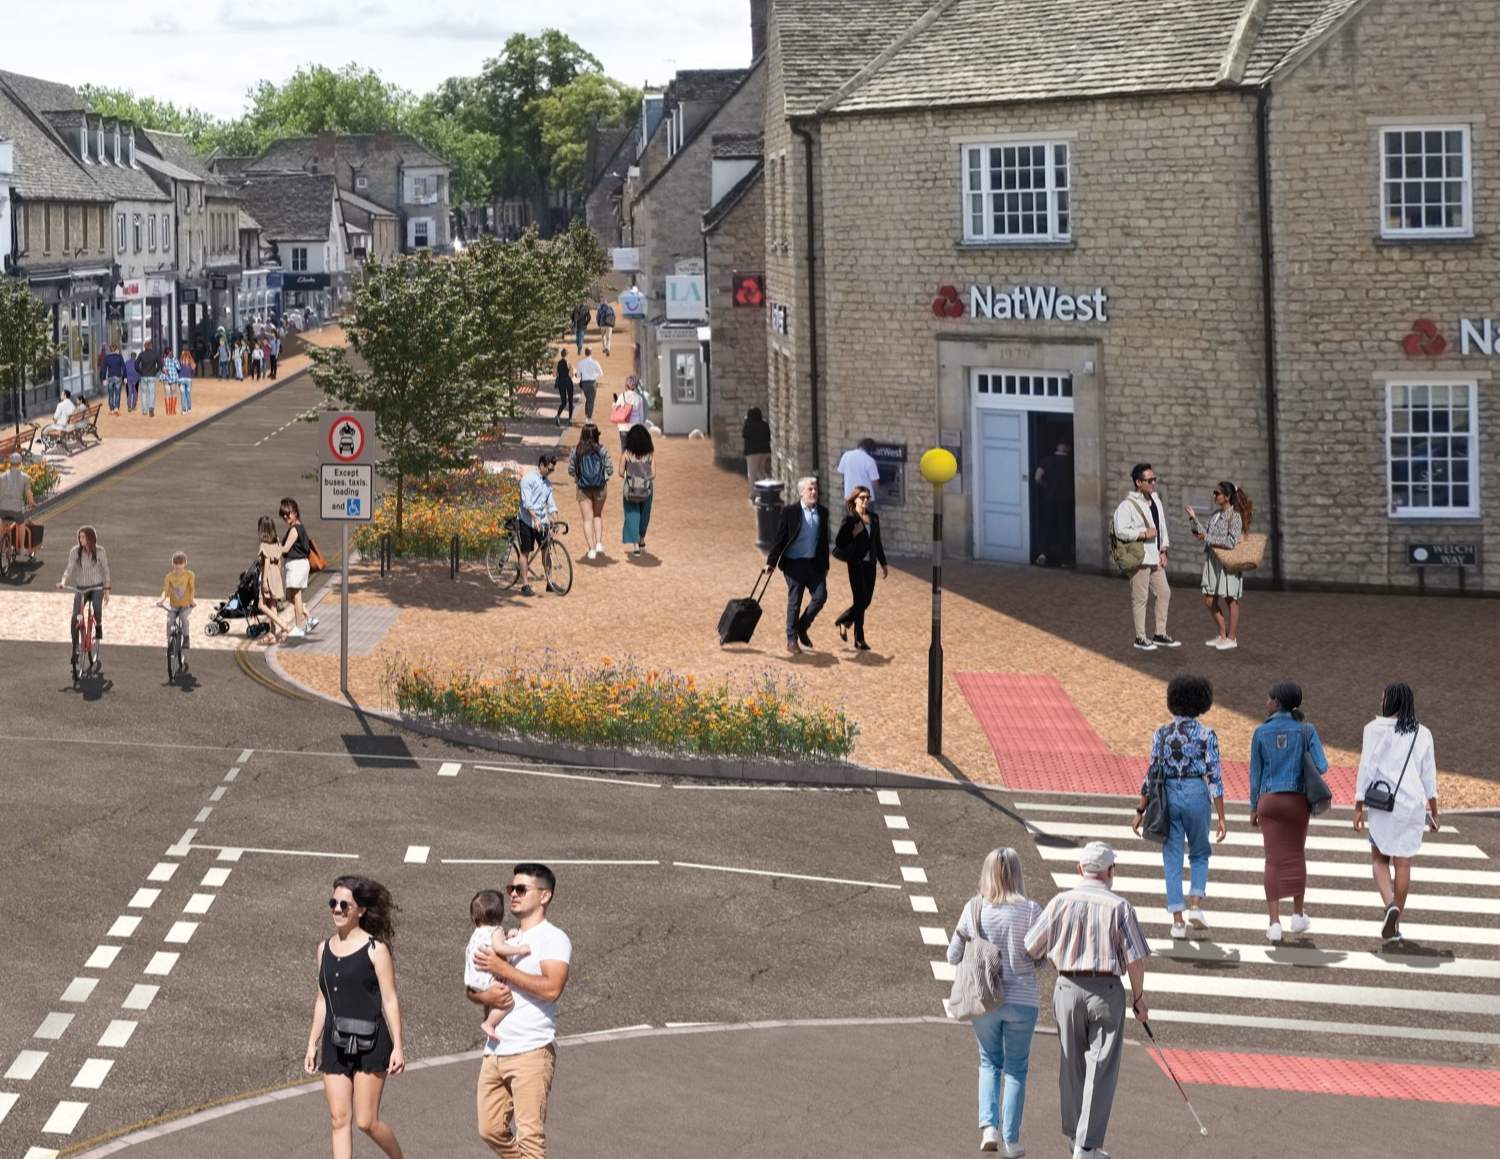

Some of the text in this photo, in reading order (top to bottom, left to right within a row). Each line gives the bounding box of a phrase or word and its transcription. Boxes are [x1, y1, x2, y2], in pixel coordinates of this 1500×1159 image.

[669, 281, 702, 302] LA
[970, 285, 1107, 322] NatWest
[874, 446, 902, 458] atWest
[334, 468, 359, 478] Except
[333, 487, 359, 497] loading
[332, 502, 345, 510] and
[1432, 544, 1474, 554] WELCH
[1440, 555, 1466, 564] WAY
